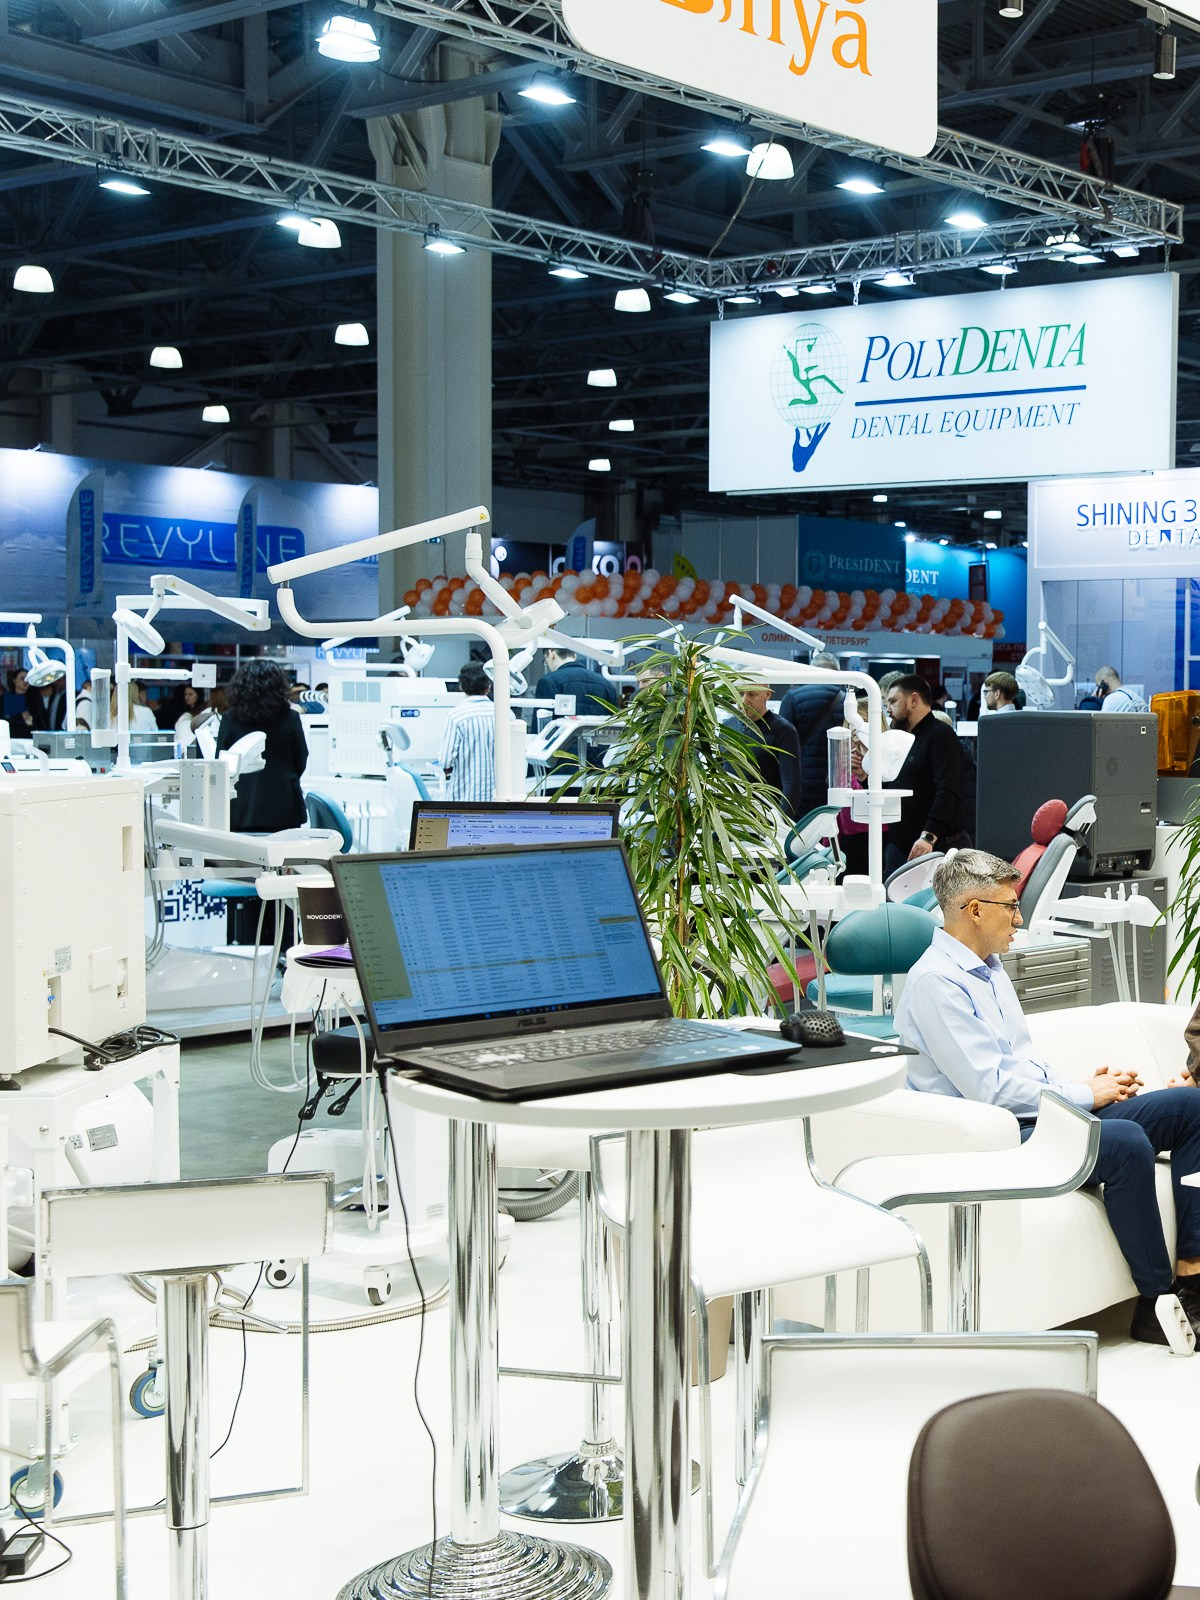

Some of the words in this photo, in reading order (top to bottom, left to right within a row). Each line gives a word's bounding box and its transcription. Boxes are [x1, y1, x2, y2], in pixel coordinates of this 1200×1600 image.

[851, 412, 933, 439] DENTAL
[940, 402, 1081, 438] EQUIPMENT
[1076, 500, 1177, 527] SHINING
